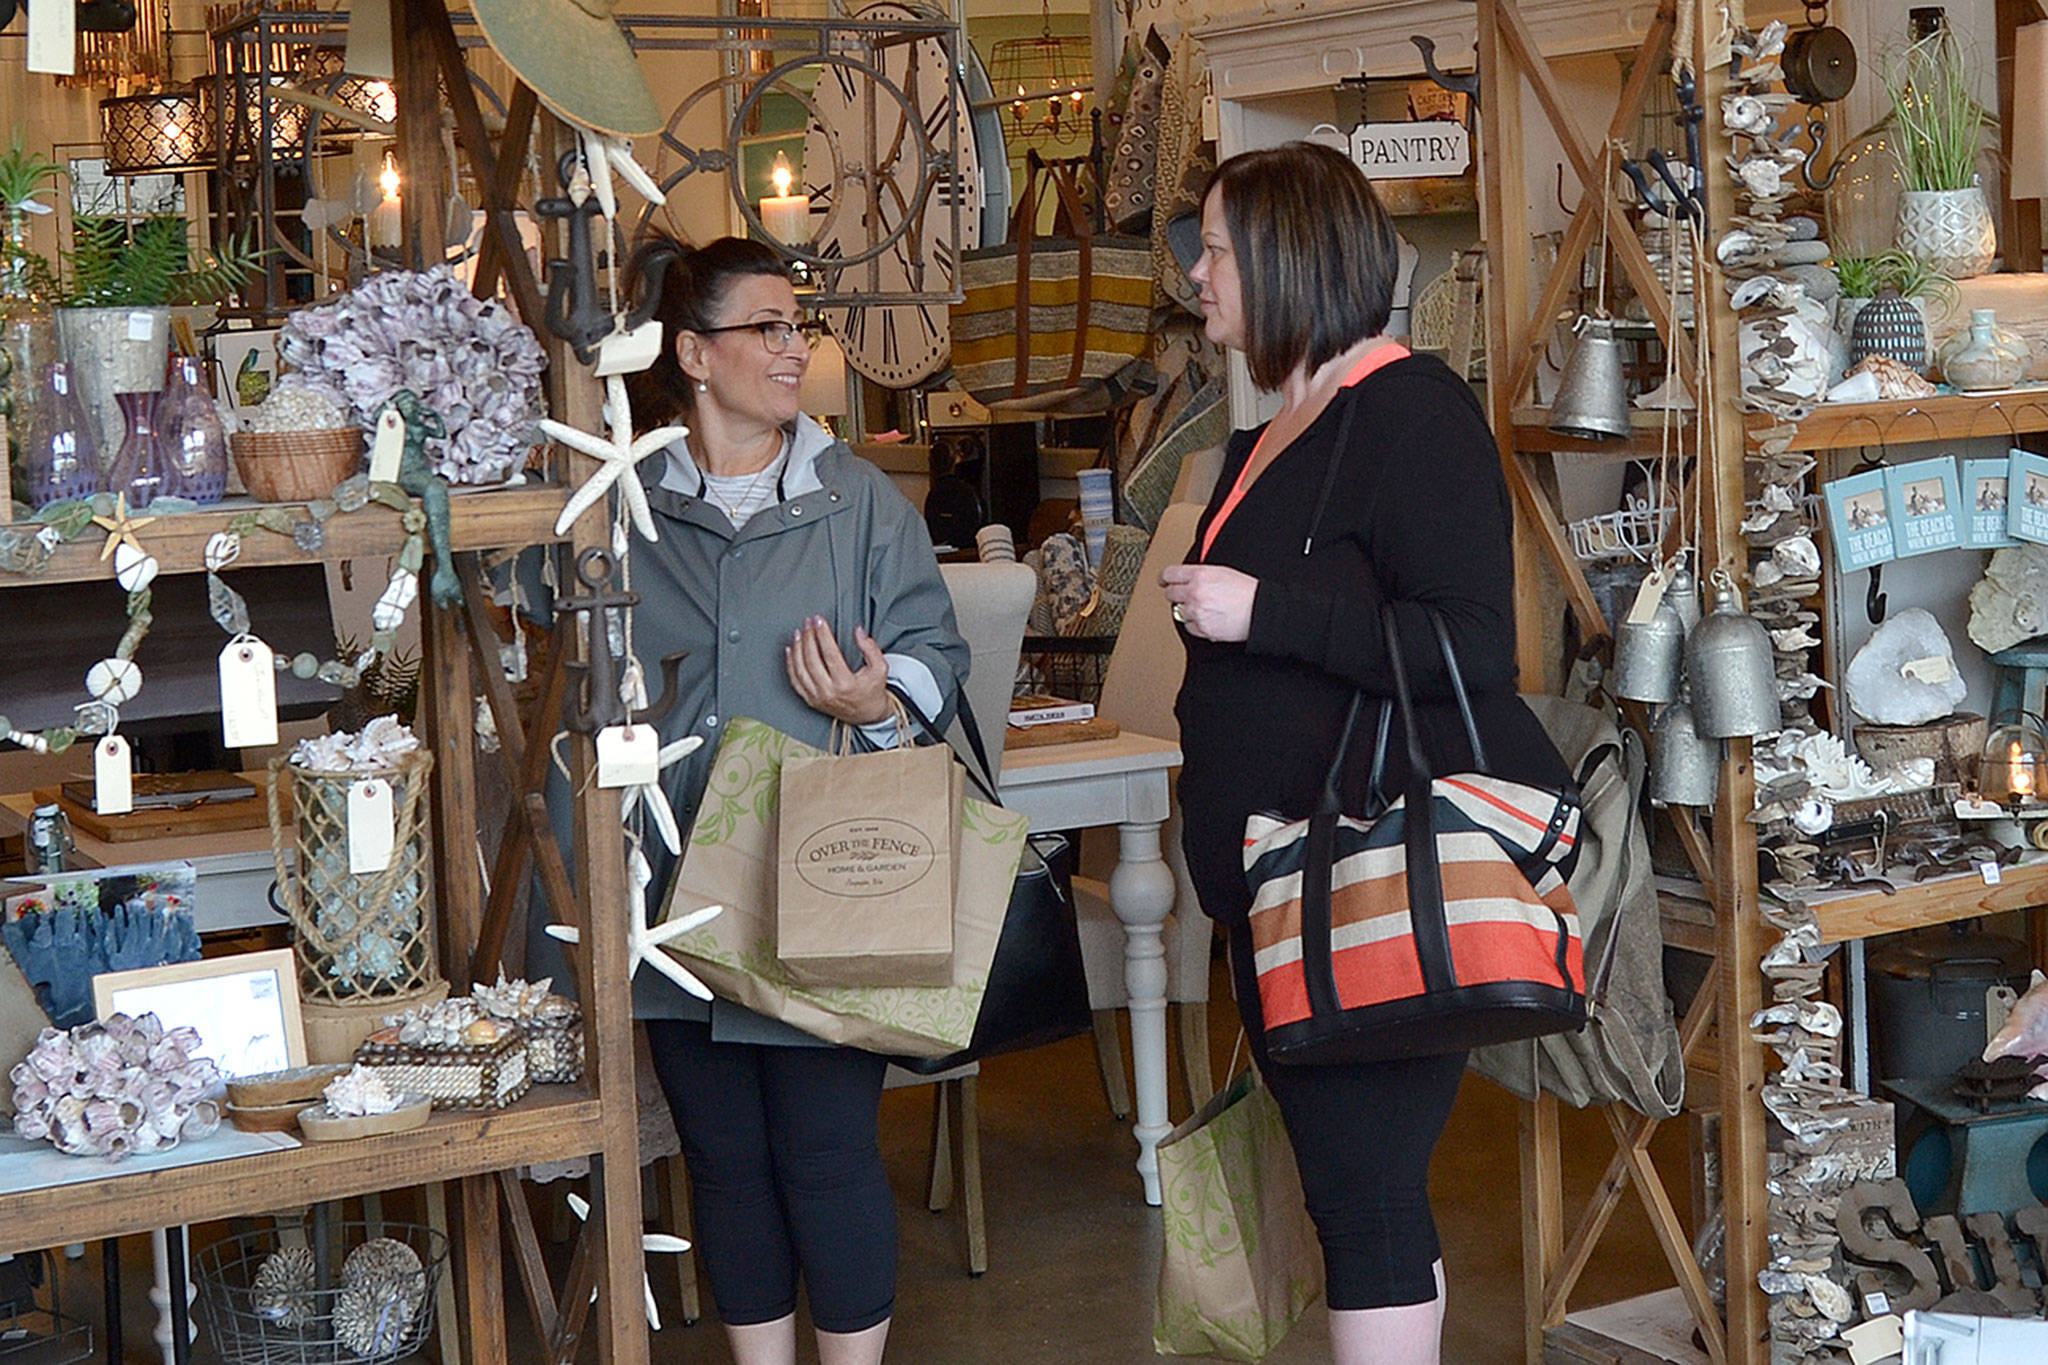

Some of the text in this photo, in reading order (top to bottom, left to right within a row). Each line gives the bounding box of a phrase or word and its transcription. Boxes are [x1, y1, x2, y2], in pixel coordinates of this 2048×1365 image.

[1361, 136, 1460, 164] PANTRY
[1904, 514, 1955, 538] THE BEACH IS
[1847, 535, 1865, 554] THE
[1863, 529, 1889, 550] BEACH
[809, 840, 850, 863] OVER
[872, 837, 920, 857] FENCE
[827, 863, 907, 874] HOME & GARDEN
